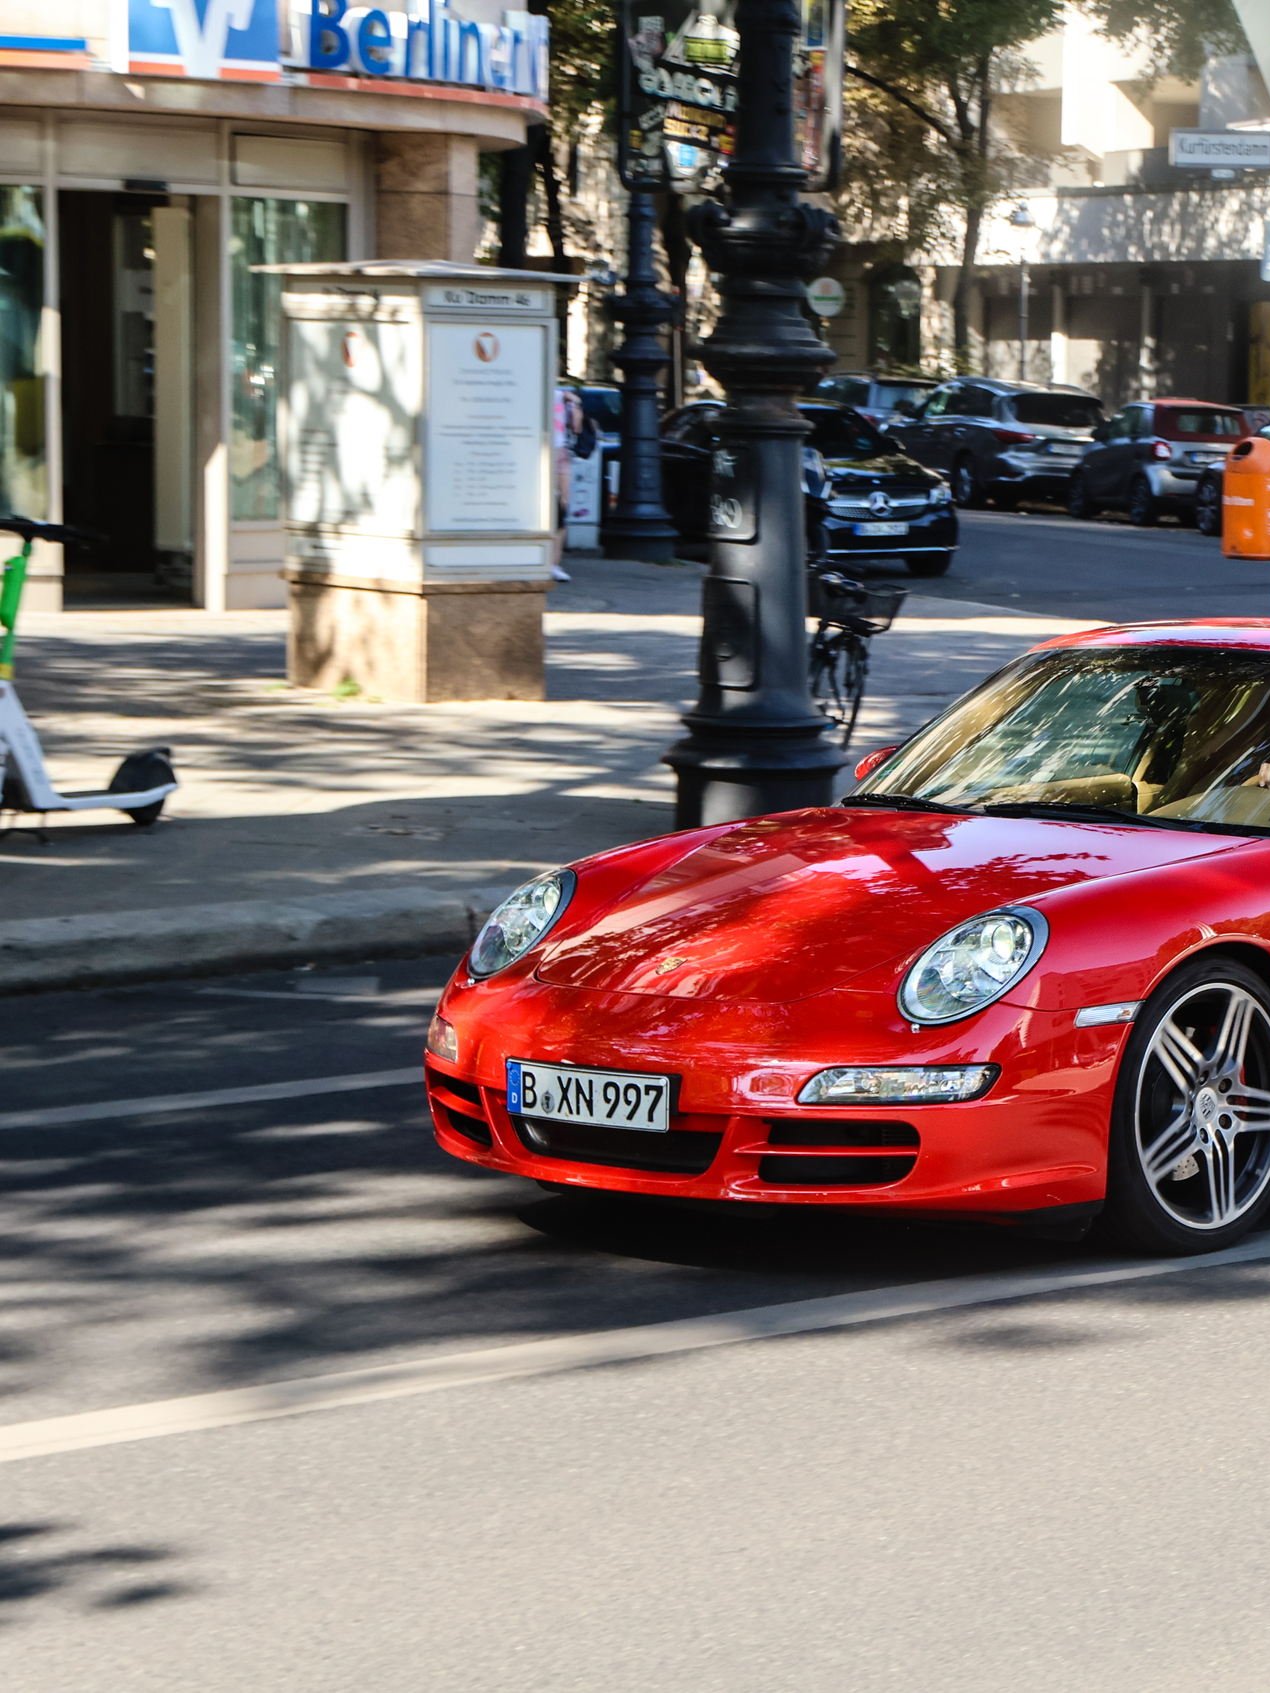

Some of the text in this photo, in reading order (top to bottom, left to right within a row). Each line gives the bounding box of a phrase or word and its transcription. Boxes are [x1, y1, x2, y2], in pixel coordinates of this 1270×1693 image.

[1178, 136, 1269, 157] Kurfürstendamm
[511, 1092, 518, 1104] D
[522, 1071, 664, 1122] B XN 997
